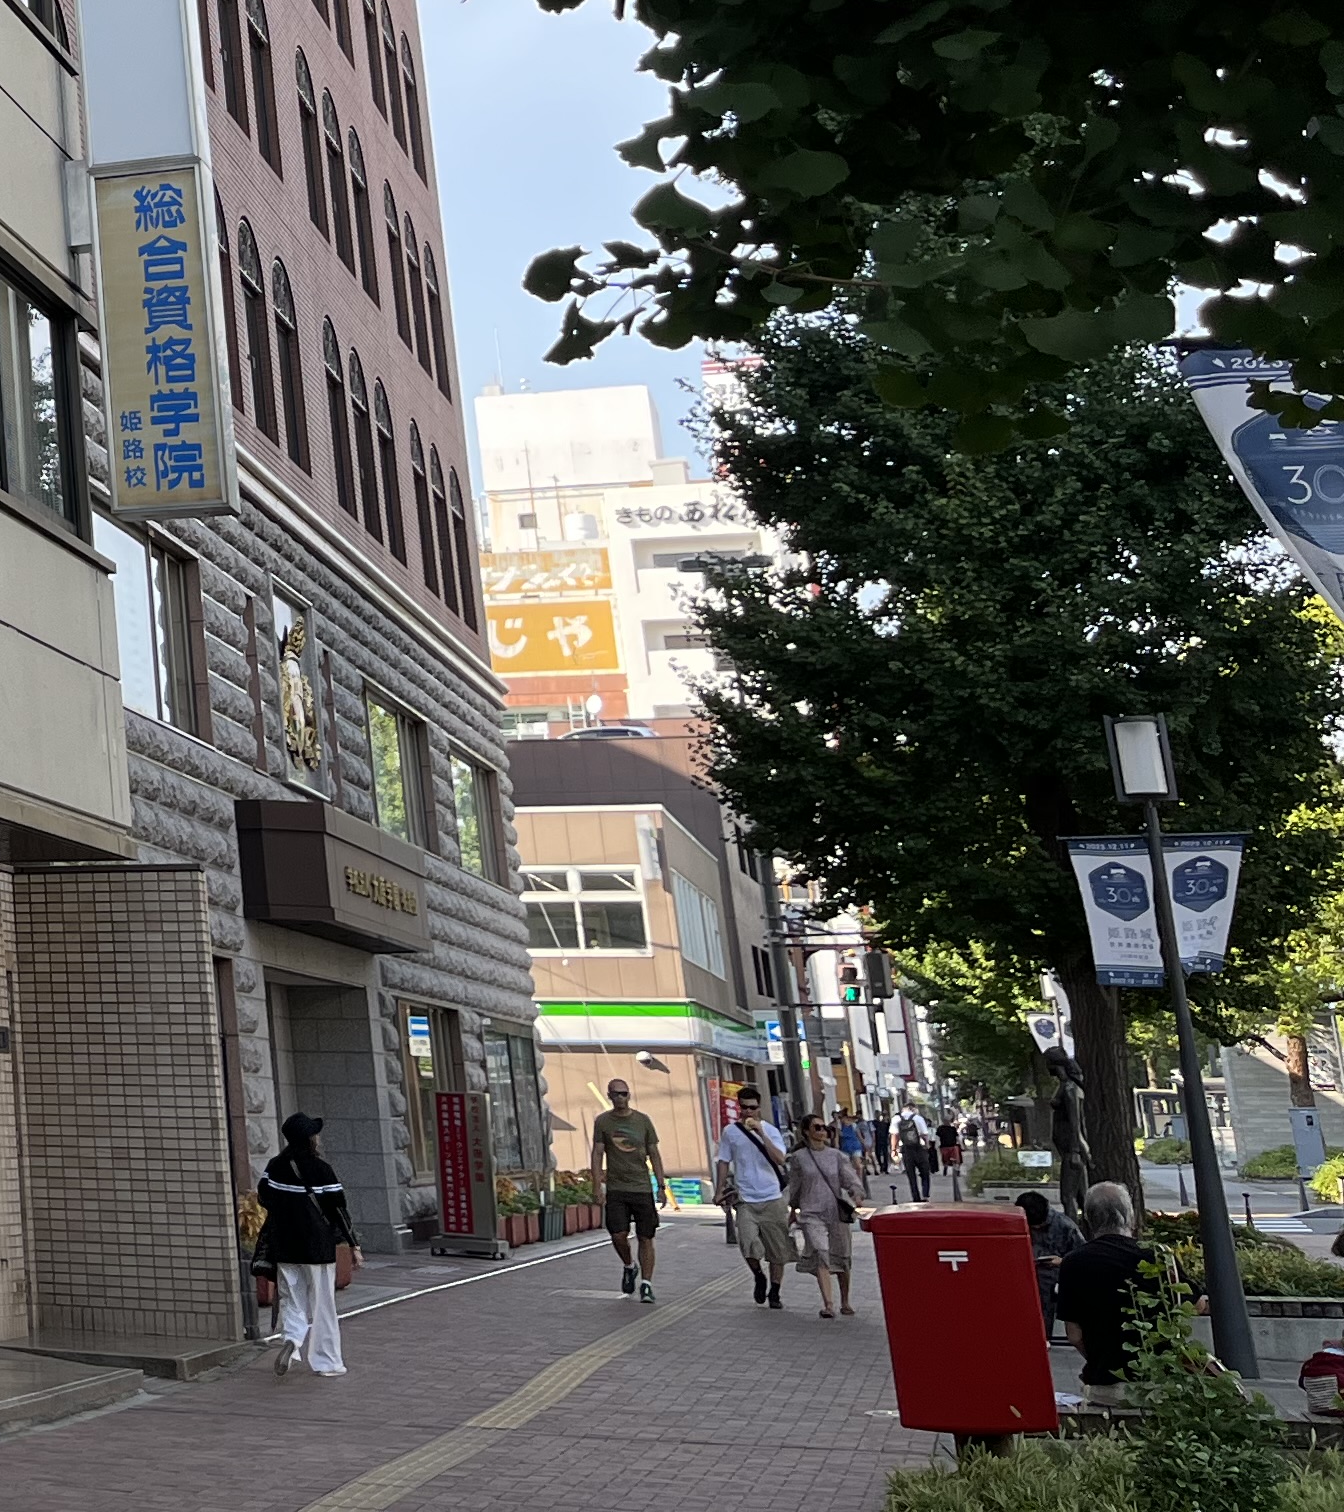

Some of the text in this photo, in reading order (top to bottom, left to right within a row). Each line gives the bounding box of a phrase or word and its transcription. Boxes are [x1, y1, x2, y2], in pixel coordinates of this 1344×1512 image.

[133, 183, 205, 491] 総合資格学院
[119, 410, 148, 488] 姫路校
